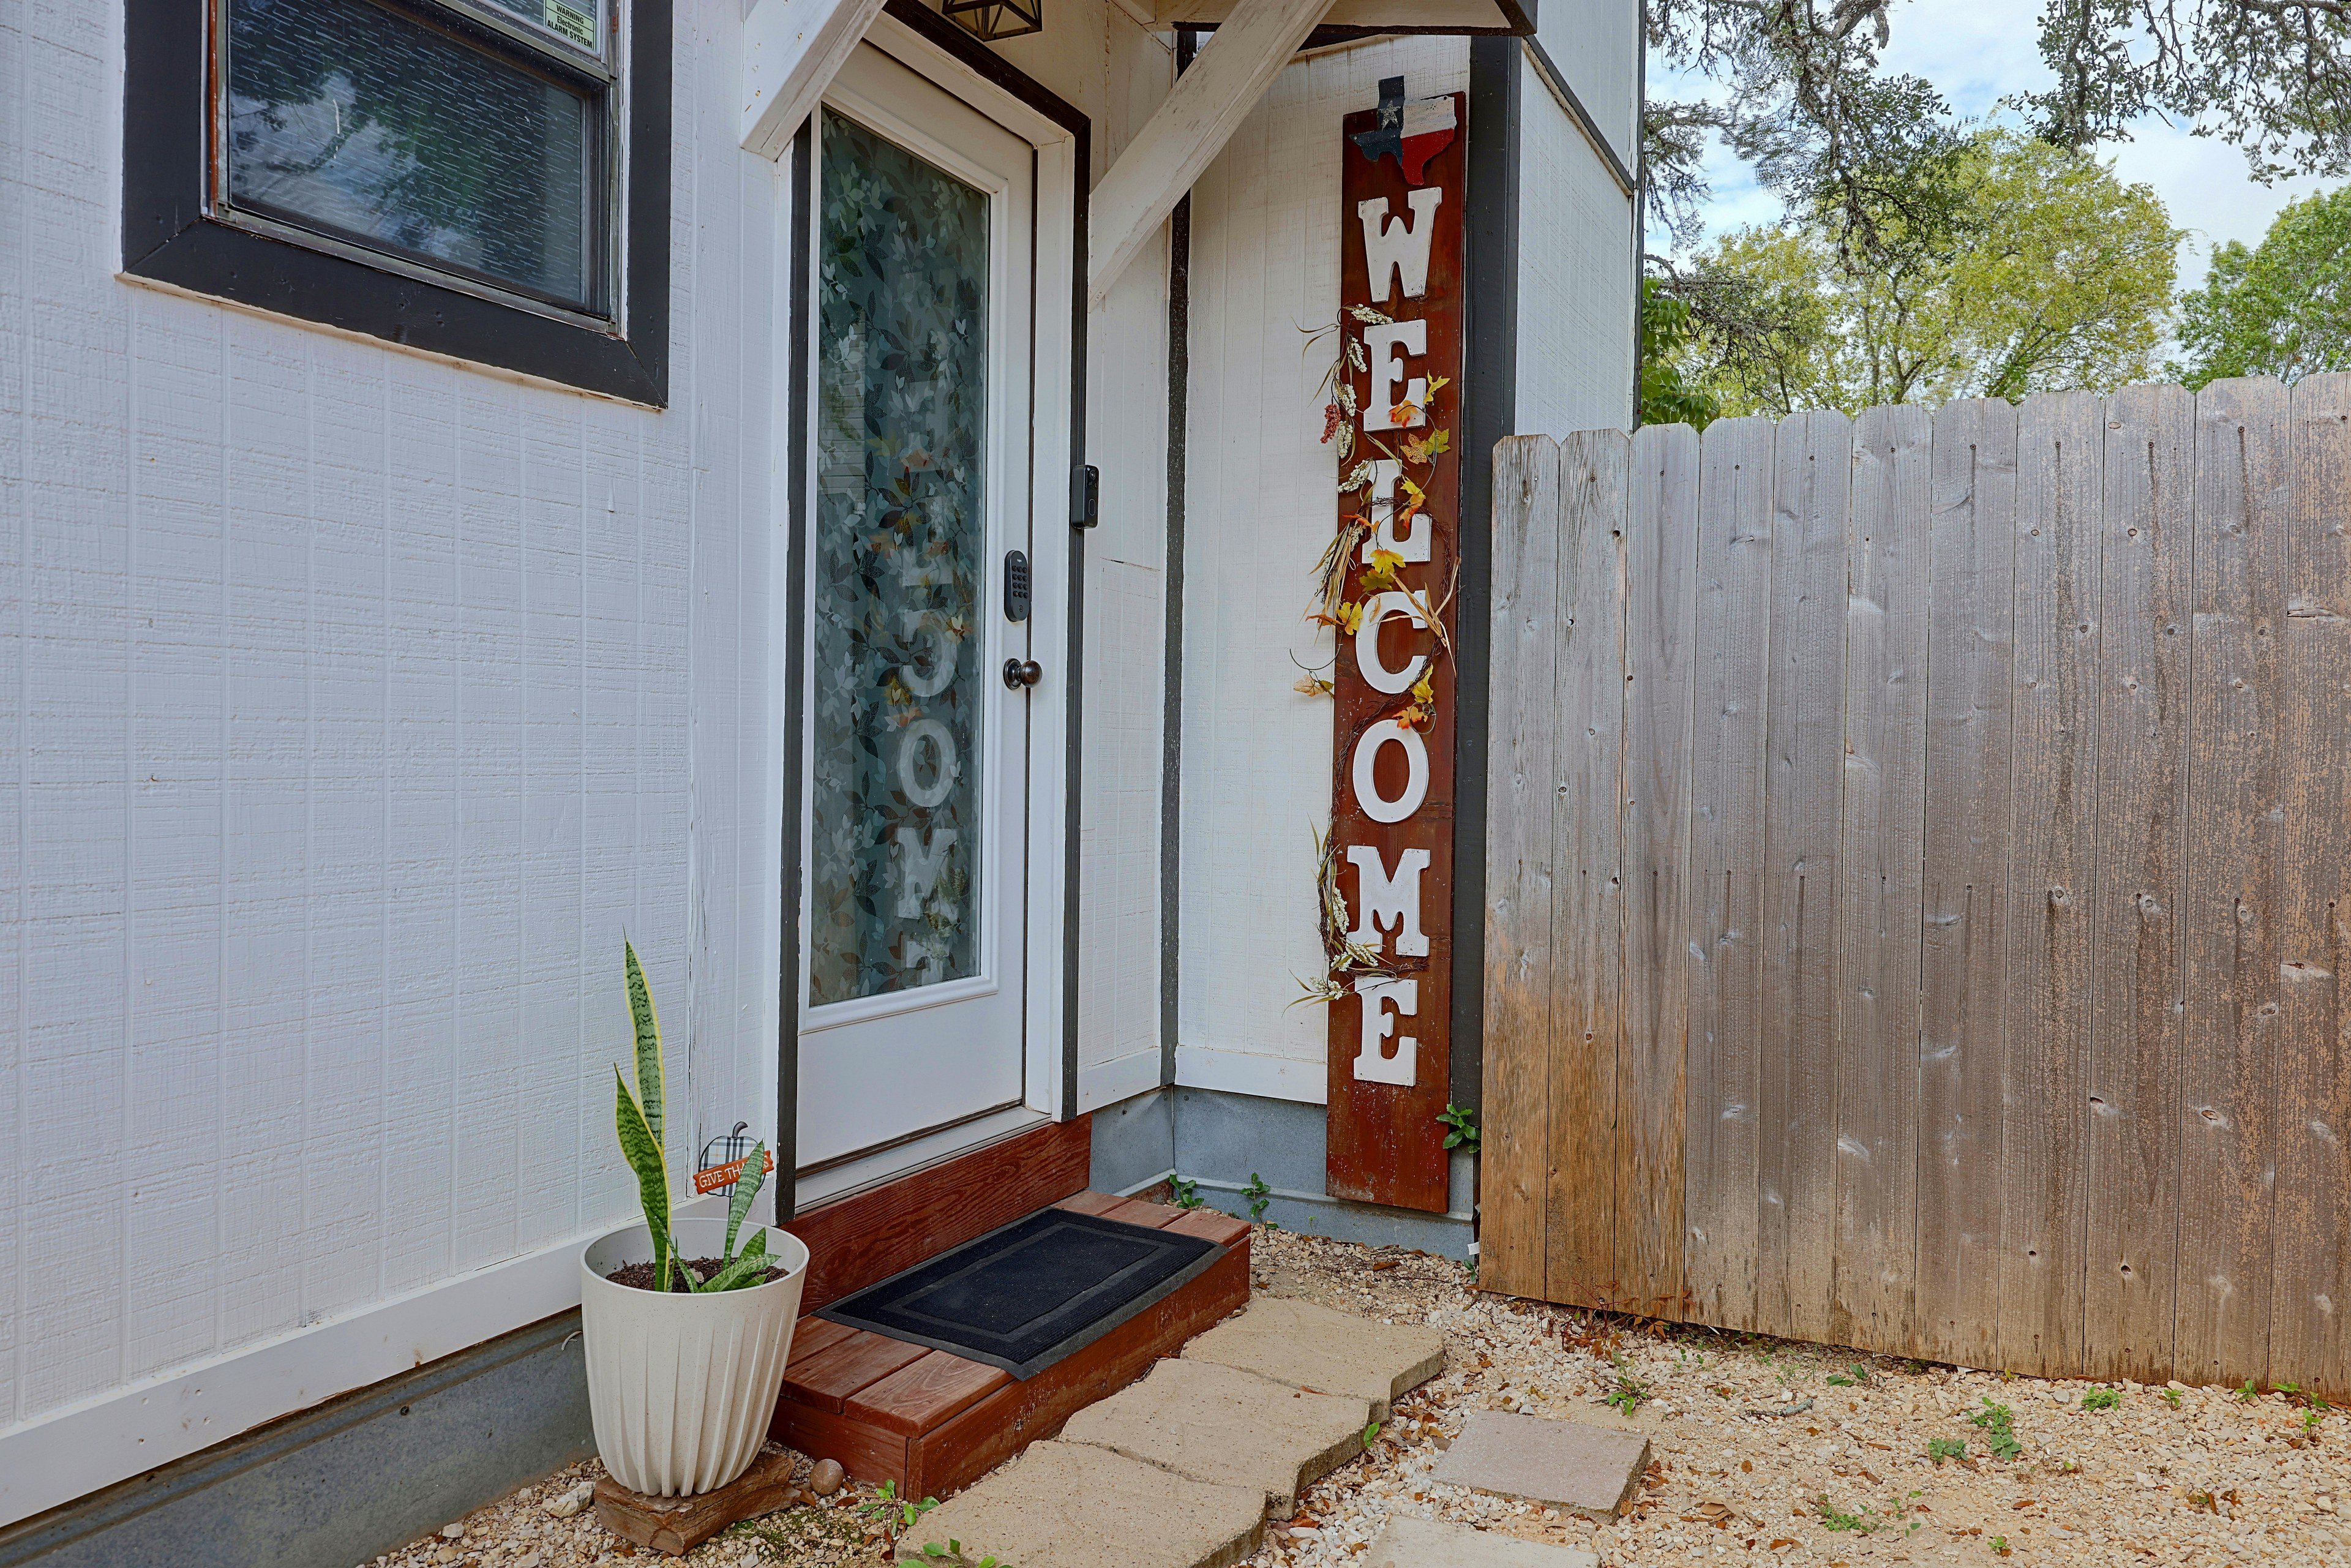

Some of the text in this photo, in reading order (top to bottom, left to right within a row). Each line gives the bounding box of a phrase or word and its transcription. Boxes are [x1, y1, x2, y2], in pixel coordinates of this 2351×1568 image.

[557, 4, 583, 24] WARNING
[547, 20, 592, 48] ALARM SYSTEM
[557, 15, 583, 35] Electronic
[1347, 186, 1442, 1087] WELCOME
[699, 1170, 725, 1188] GIVE
